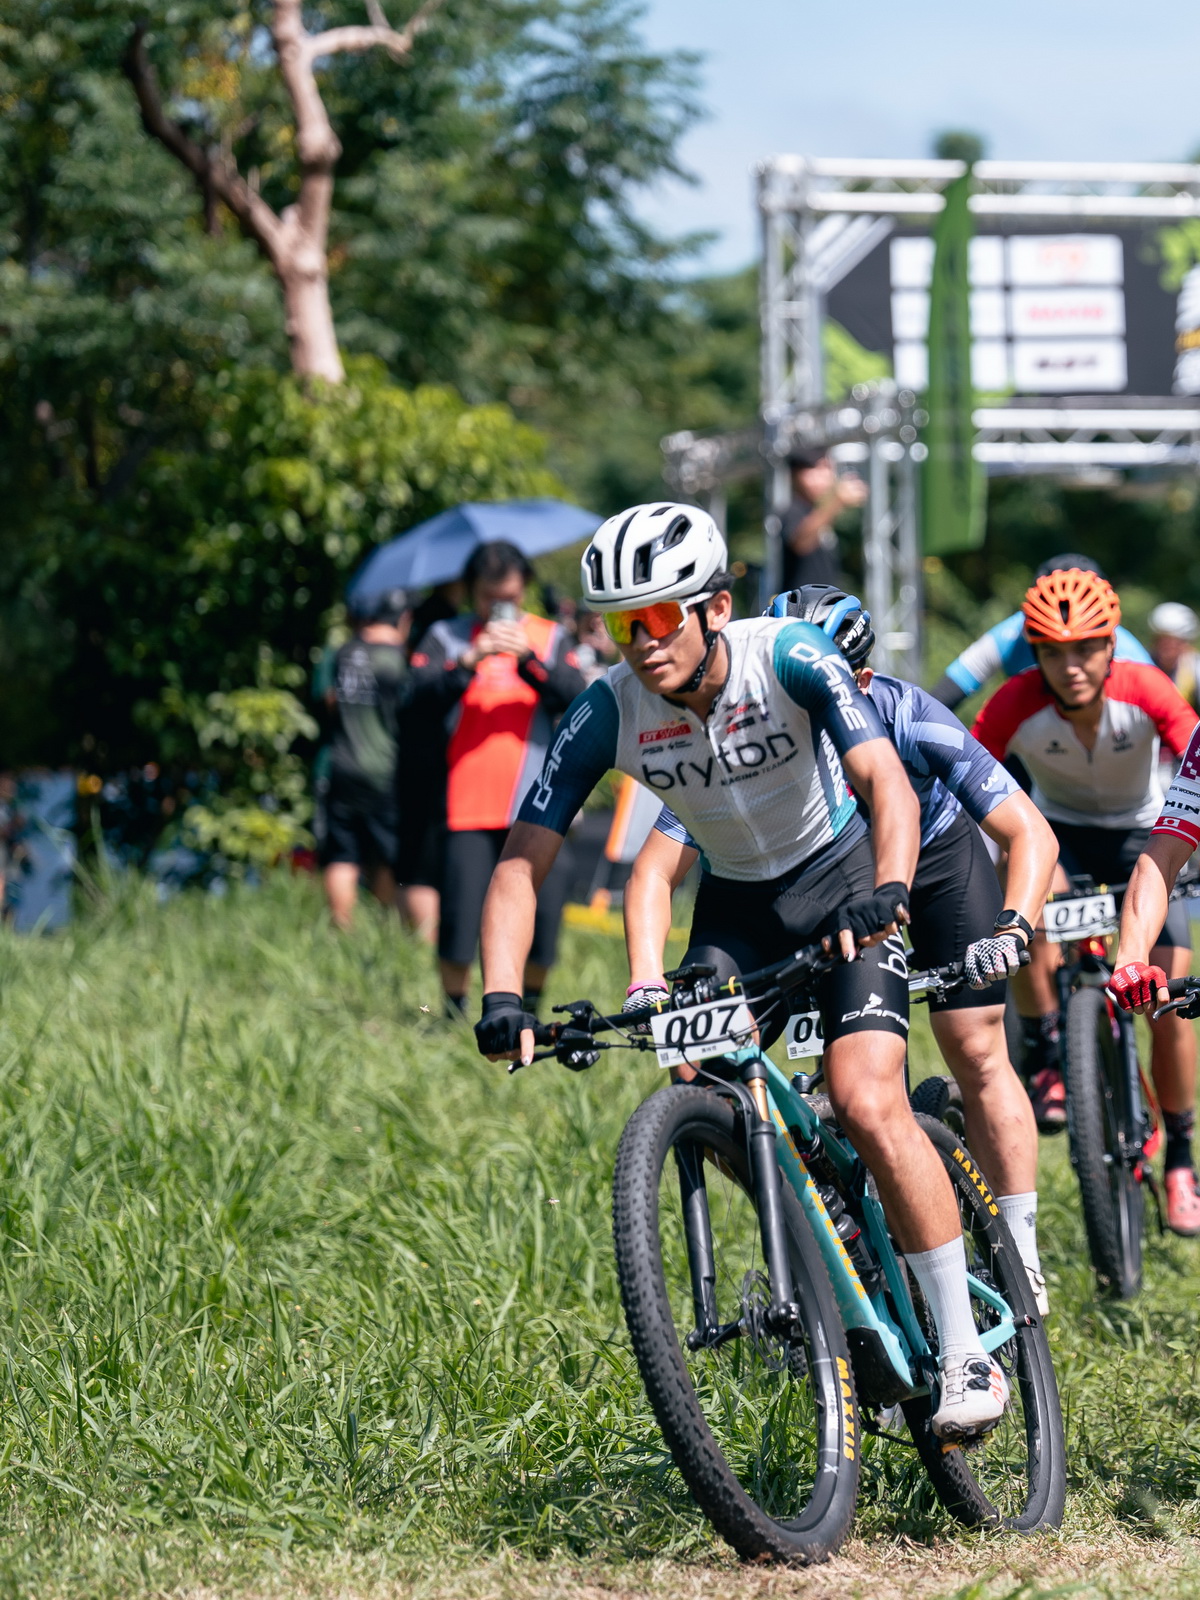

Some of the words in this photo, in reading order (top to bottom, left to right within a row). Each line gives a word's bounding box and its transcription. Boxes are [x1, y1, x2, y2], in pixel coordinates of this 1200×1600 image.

[841, 615, 866, 649] MET
[789, 642, 868, 732] DARE
[532, 700, 593, 812] DARE
[641, 731, 796, 791] bryton
[665, 1004, 741, 1047] 007
[952, 1147, 999, 1217] MAXXIS
[835, 1356, 856, 1462] MAXXIS
